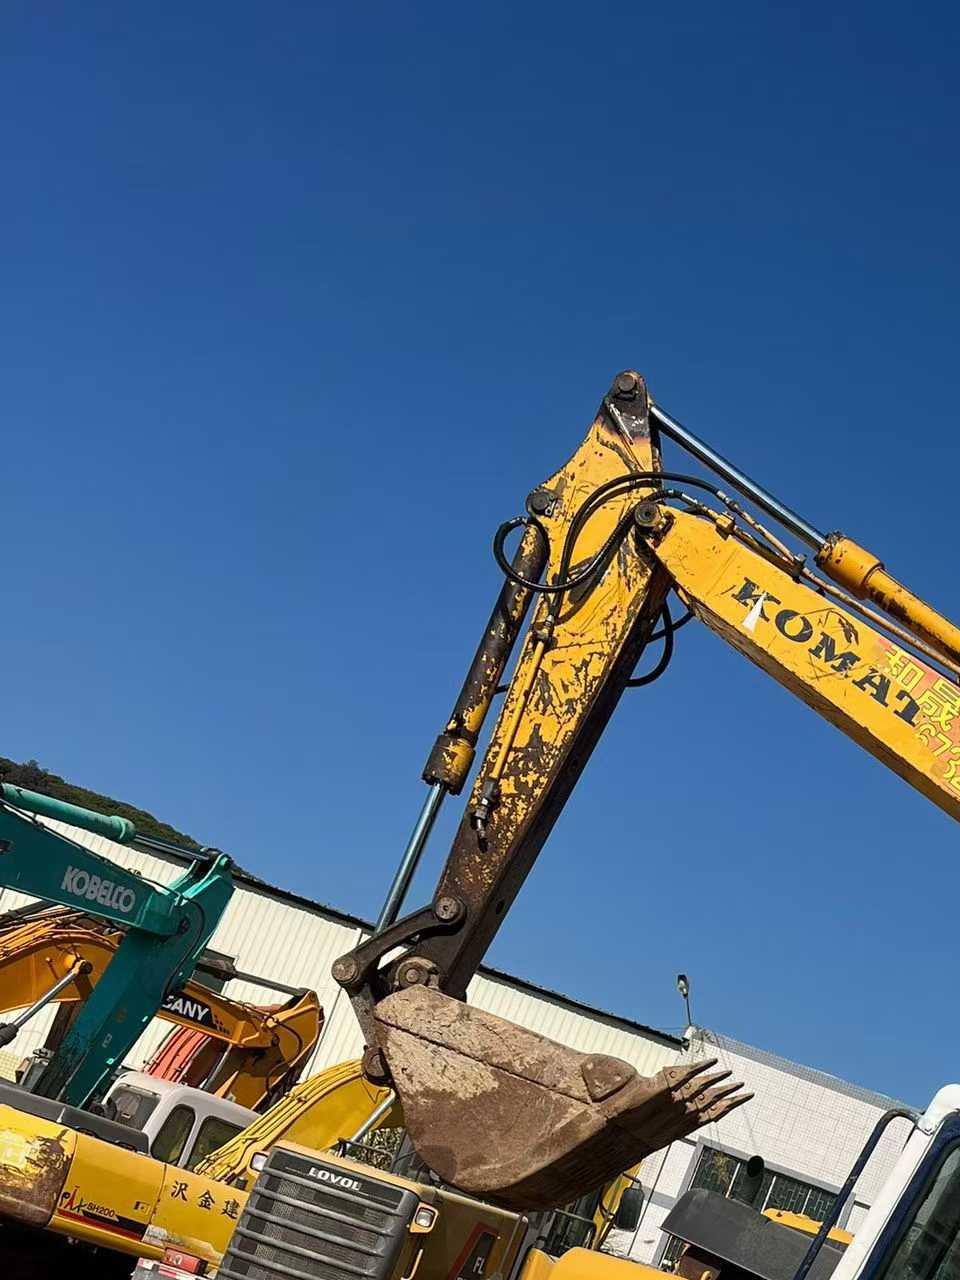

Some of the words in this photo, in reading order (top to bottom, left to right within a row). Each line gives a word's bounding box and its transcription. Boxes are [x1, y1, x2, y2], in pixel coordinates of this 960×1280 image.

[60, 865, 136, 913] KOBELCO
[308, 1166, 361, 1191] LOVOL
[86, 1202, 116, 1218] SH200
[472, 1256, 485, 1275] FL
